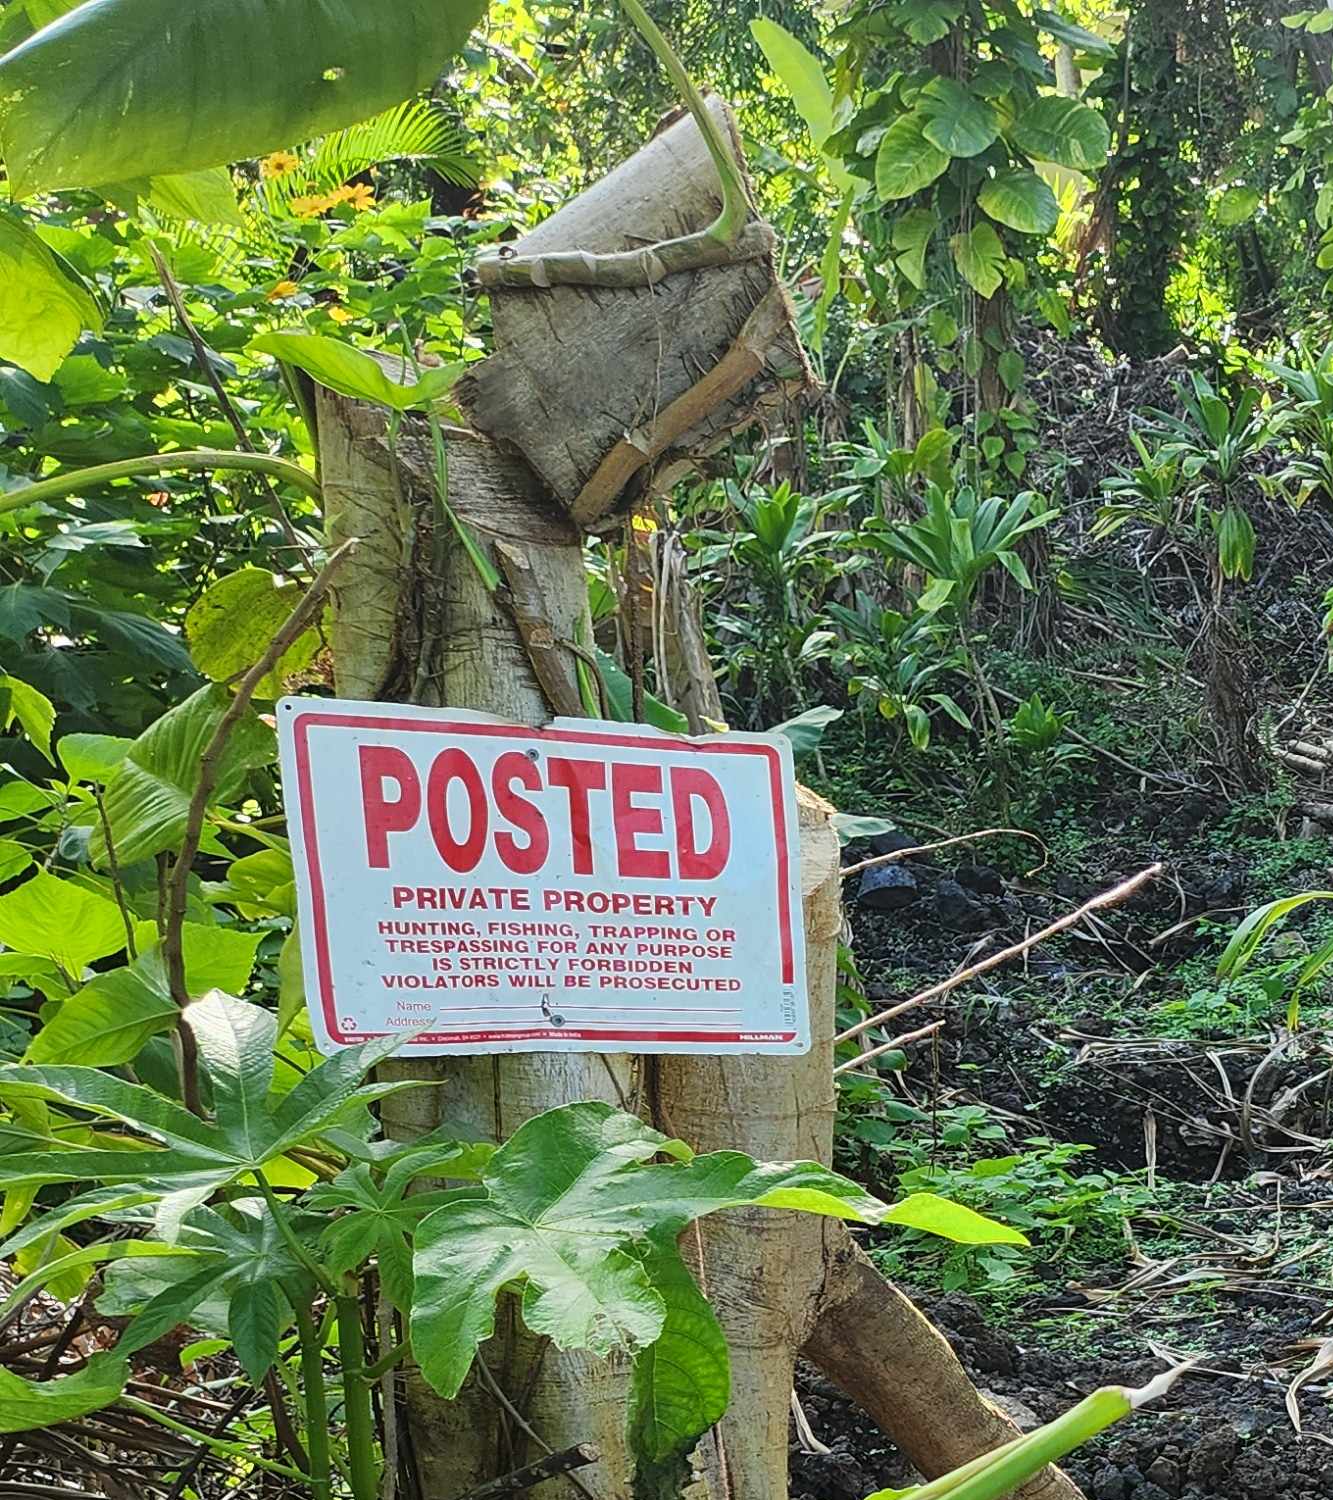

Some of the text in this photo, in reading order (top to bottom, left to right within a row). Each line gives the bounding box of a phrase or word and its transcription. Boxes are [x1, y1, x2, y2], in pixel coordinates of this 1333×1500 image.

[358, 745, 731, 880] POSTED
[392, 886, 718, 917] PRIVATE PROPERTY
[378, 921, 737, 942] HUNTING, FISHING, TRAPPING OR
[385, 939, 733, 959] TRESPASSING FOR ANY PURPOSE
[432, 957, 693, 974] IS STRICTLY FORBIDDEN
[382, 975, 742, 992] VIOLATORS WILL BE PROSECUTED
[396, 1001, 432, 1011] Name
